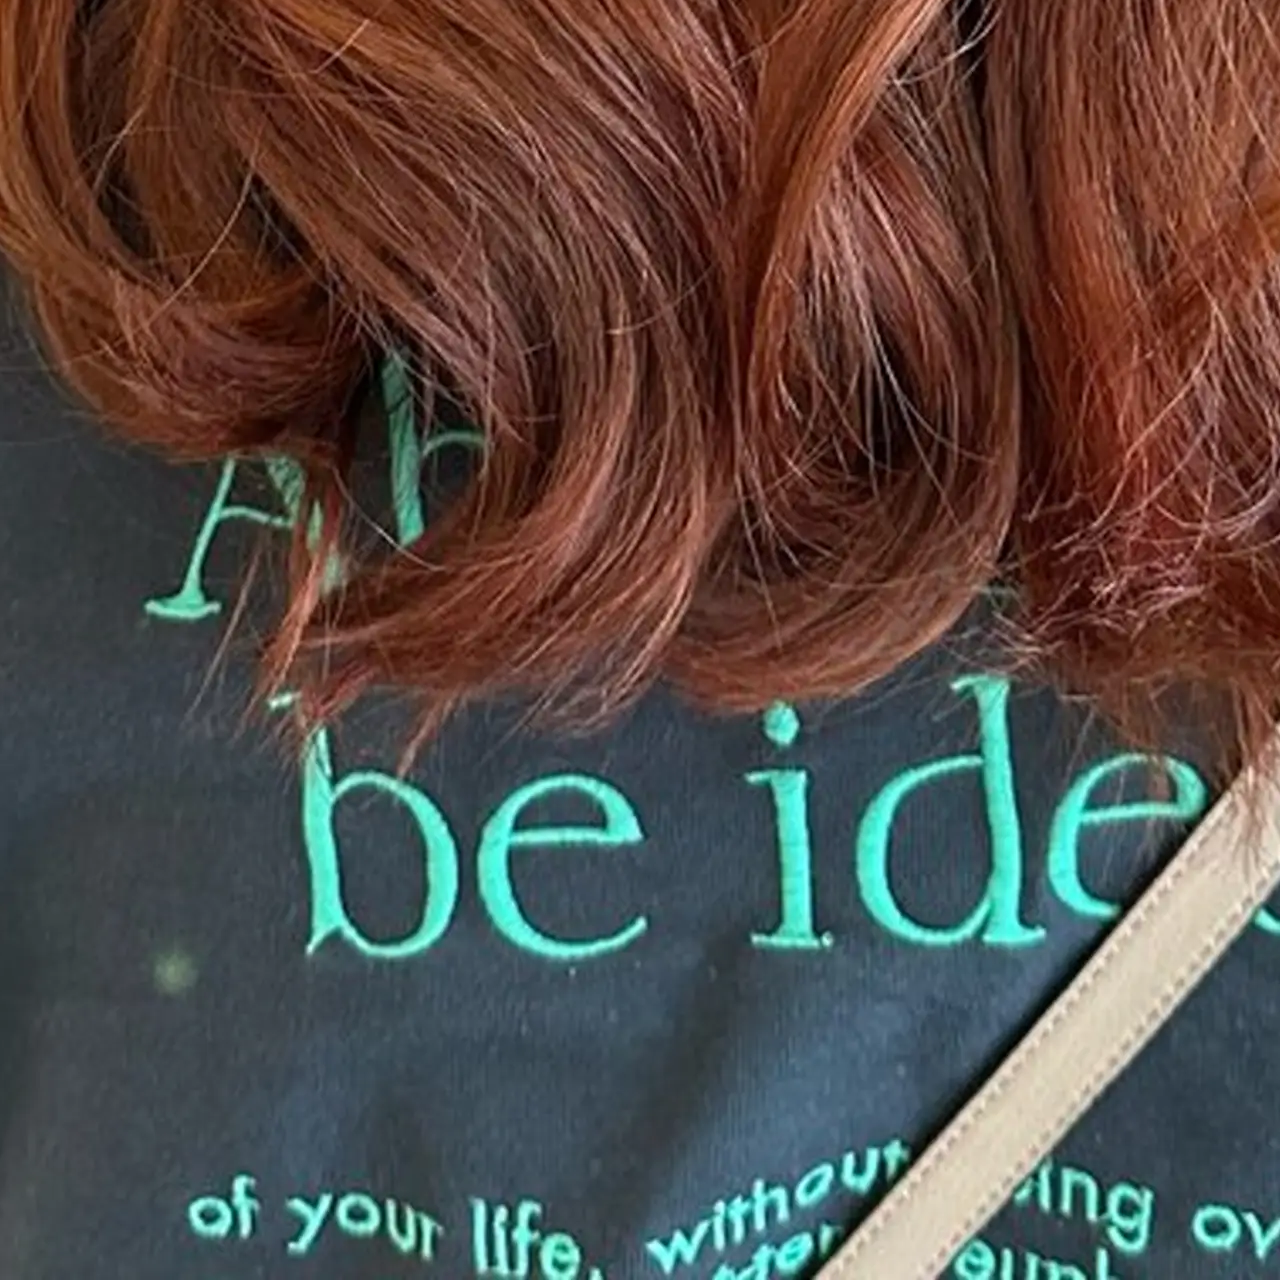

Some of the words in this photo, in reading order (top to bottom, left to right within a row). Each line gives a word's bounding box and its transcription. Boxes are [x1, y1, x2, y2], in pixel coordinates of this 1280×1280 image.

[268, 672, 648, 960] be
[187, 1174, 260, 1239] of
[286, 1190, 444, 1261] your
[646, 1139, 908, 1274] without
